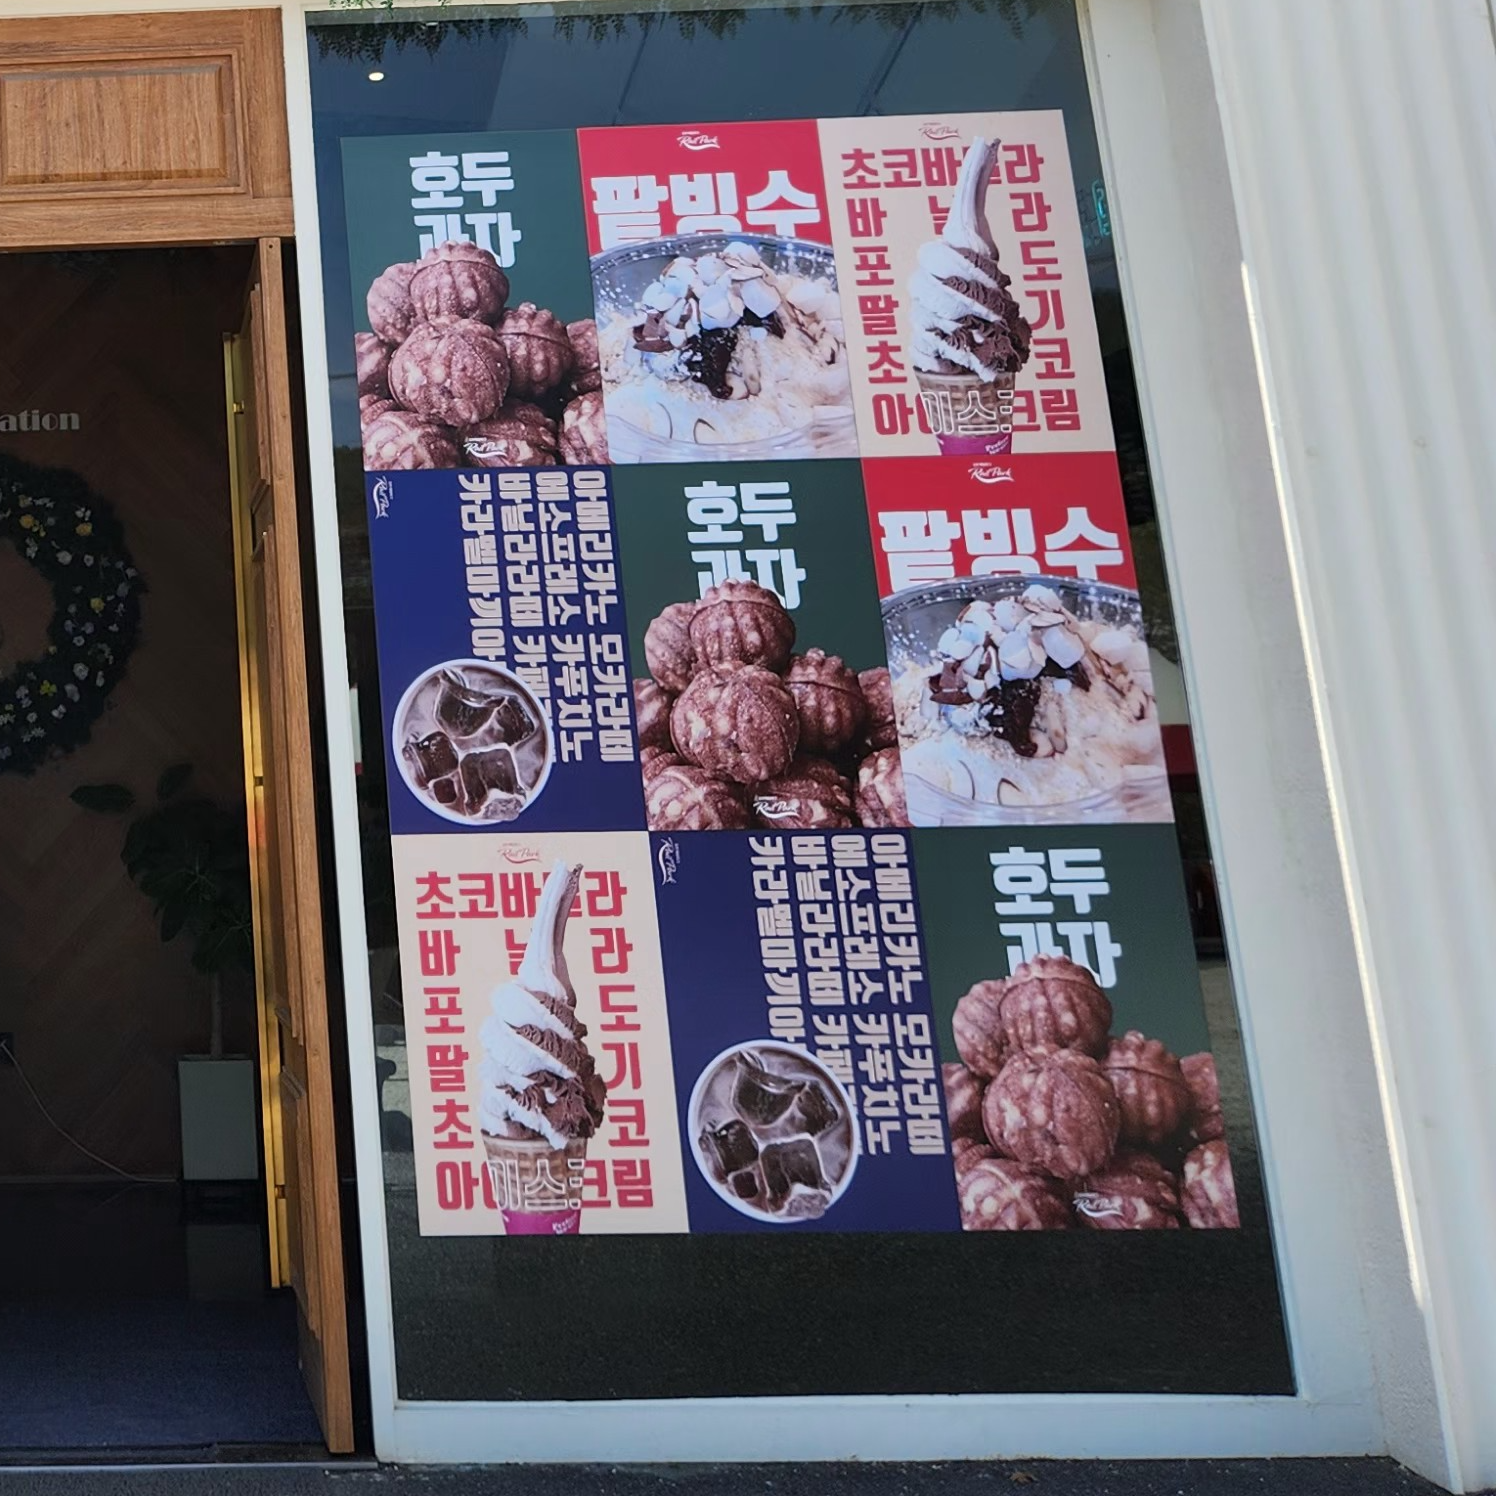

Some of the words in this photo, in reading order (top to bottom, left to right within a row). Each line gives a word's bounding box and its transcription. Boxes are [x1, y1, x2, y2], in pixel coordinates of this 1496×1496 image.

[409, 151, 514, 209] 호두
[841, 143, 1045, 190] 초코바라
[590, 169, 821, 251] 팥빙수
[846, 197, 887, 237] 바
[1009, 192, 1052, 232] 라
[852, 246, 894, 286] 포
[1020, 240, 1062, 281] 도
[1024, 289, 1065, 331] 기
[866, 340, 907, 384] 초
[1033, 338, 1076, 380] 코
[871, 389, 1081, 436] 아이스크림
[684, 480, 797, 544] 호두
[498, 472, 545, 627] 바닐라라떼
[573, 470, 618, 626] 아메리카노
[878, 506, 1124, 594] 팥빙수
[551, 633, 593, 763] 카푸치노
[589, 633, 635, 763] 모카라떼
[415, 870, 627, 920] 초코바라
[989, 846, 1110, 915] 호두
[791, 835, 846, 1007] 바닐라라떼
[870, 833, 923, 1005] 아메리카노
[418, 929, 461, 977] 바
[589, 927, 633, 974] 라
[423, 986, 465, 1034] 포
[599, 984, 641, 1032] 도
[600, 1042, 643, 1090] 기
[852, 1013, 902, 1156] 카푸치노
[892, 1012, 947, 1156] 모카라떼
[432, 1099, 474, 1150] 초
[608, 1099, 650, 1148] 코
[435, 1159, 655, 1211] 아이스크림
